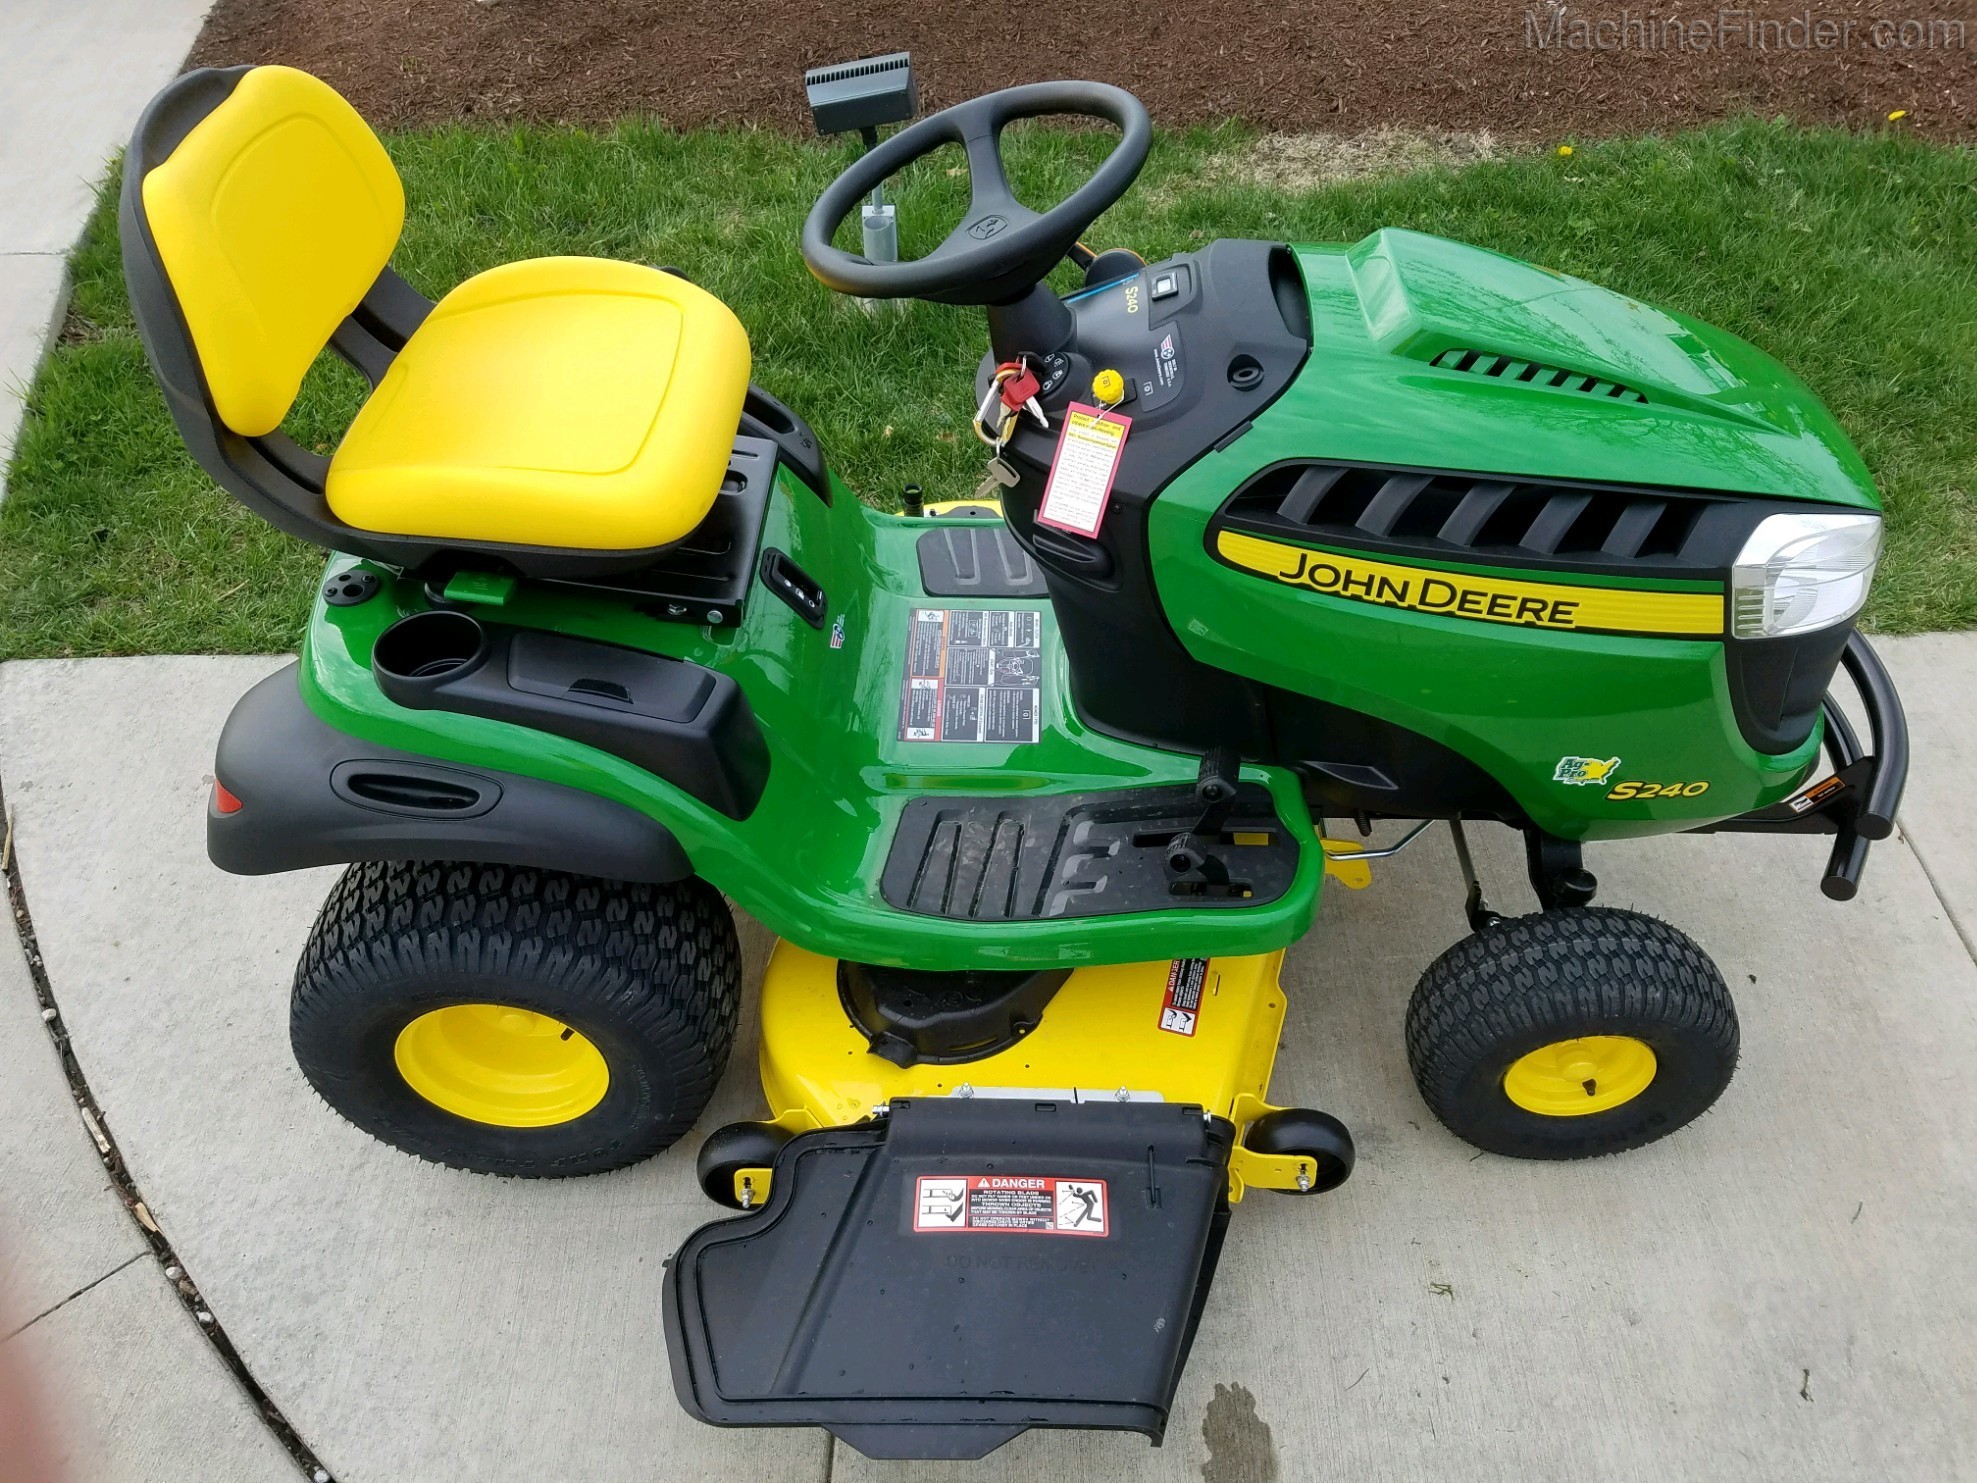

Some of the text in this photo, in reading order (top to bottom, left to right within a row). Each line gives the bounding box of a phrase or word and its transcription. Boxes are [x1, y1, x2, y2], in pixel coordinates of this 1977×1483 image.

[1125, 286, 1139, 314] S240
[1278, 553, 1579, 625] JOHN DEERE
[1558, 768, 1587, 778] Pro
[1561, 758, 1591, 770] Ag-
[1606, 782, 1709, 800] S240
[1168, 960, 1180, 986] DANGER
[992, 1178, 1045, 1189] DANGER
